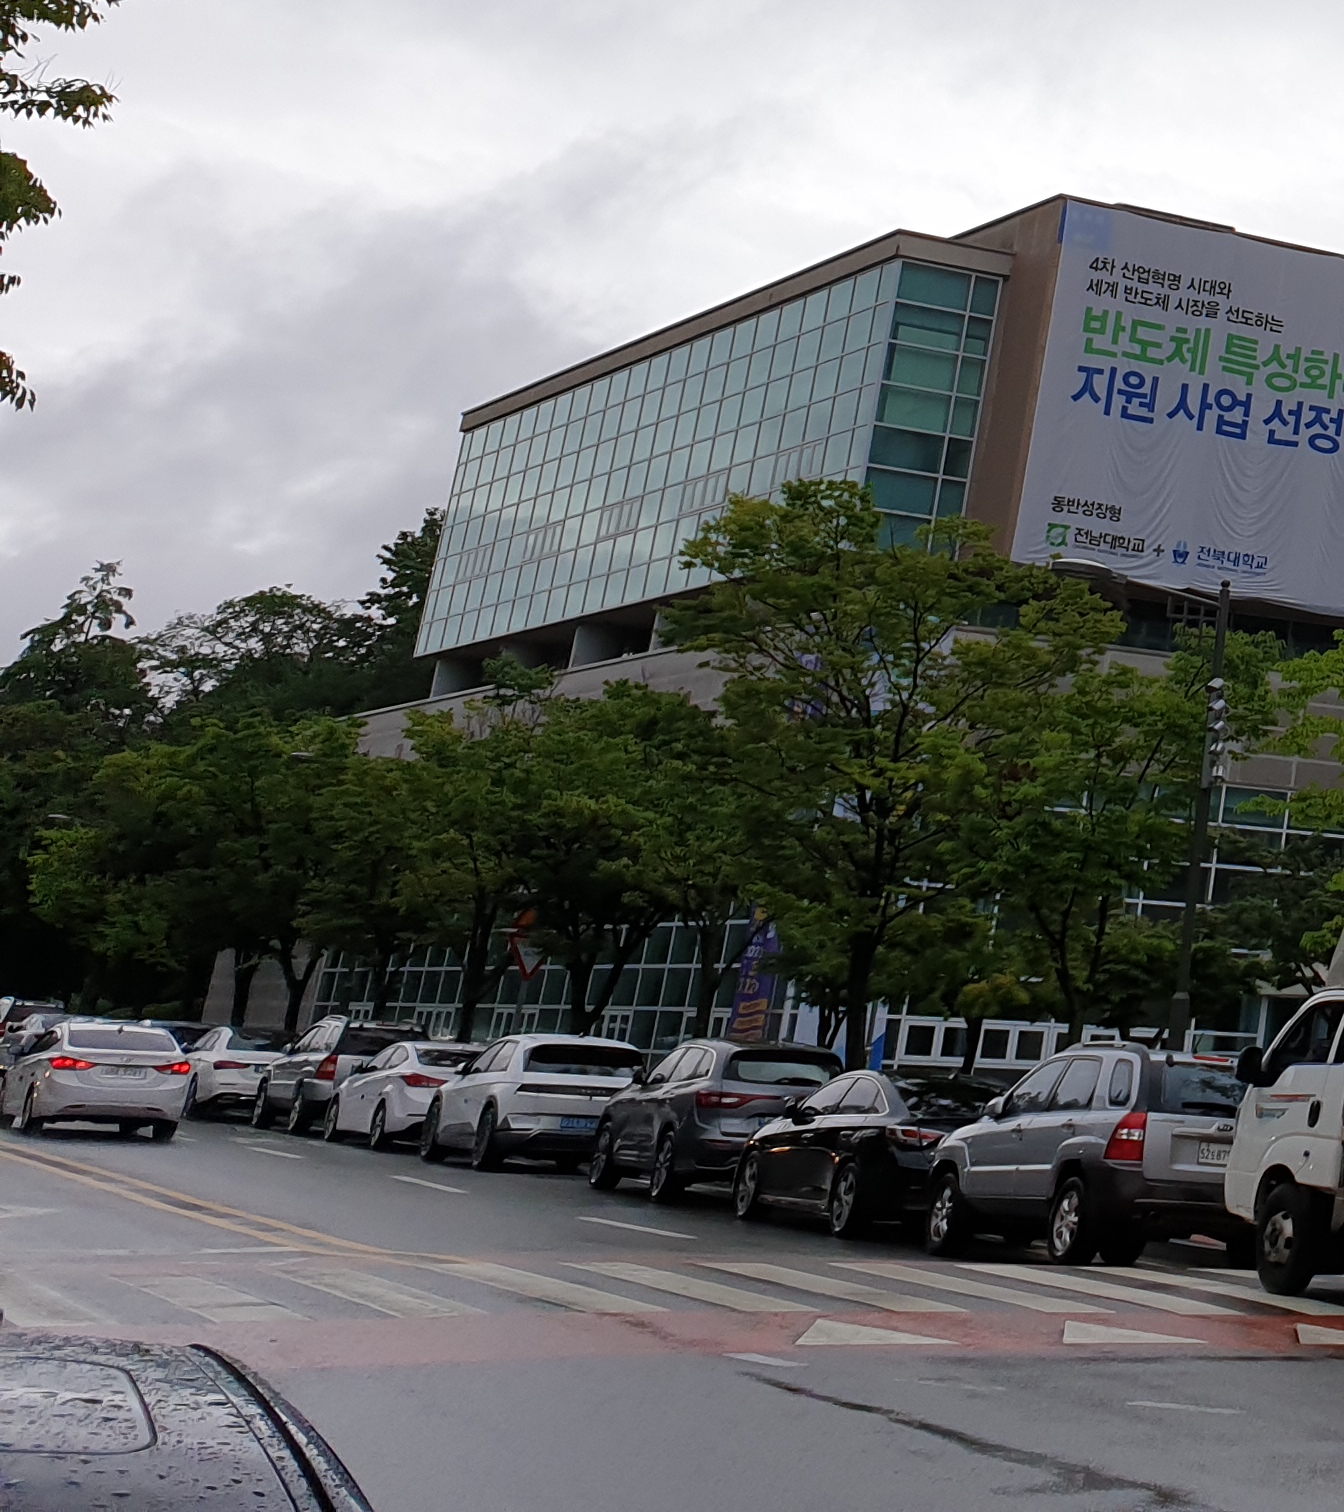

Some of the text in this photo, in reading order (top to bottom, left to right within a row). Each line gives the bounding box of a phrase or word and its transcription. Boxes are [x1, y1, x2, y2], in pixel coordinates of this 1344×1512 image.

[1089, 256, 1232, 299] 4차 산업혁명 시대와
[1086, 278, 1284, 333] 세계 반도체 시장을 선도하는
[1082, 306, 1211, 376] 반도체
[1071, 365, 1344, 454] 지원 사업 선정
[1051, 496, 1122, 522] 동반성장형
[1074, 527, 1146, 553] 전남대학교
[1197, 546, 1268, 570] 전북대학교
